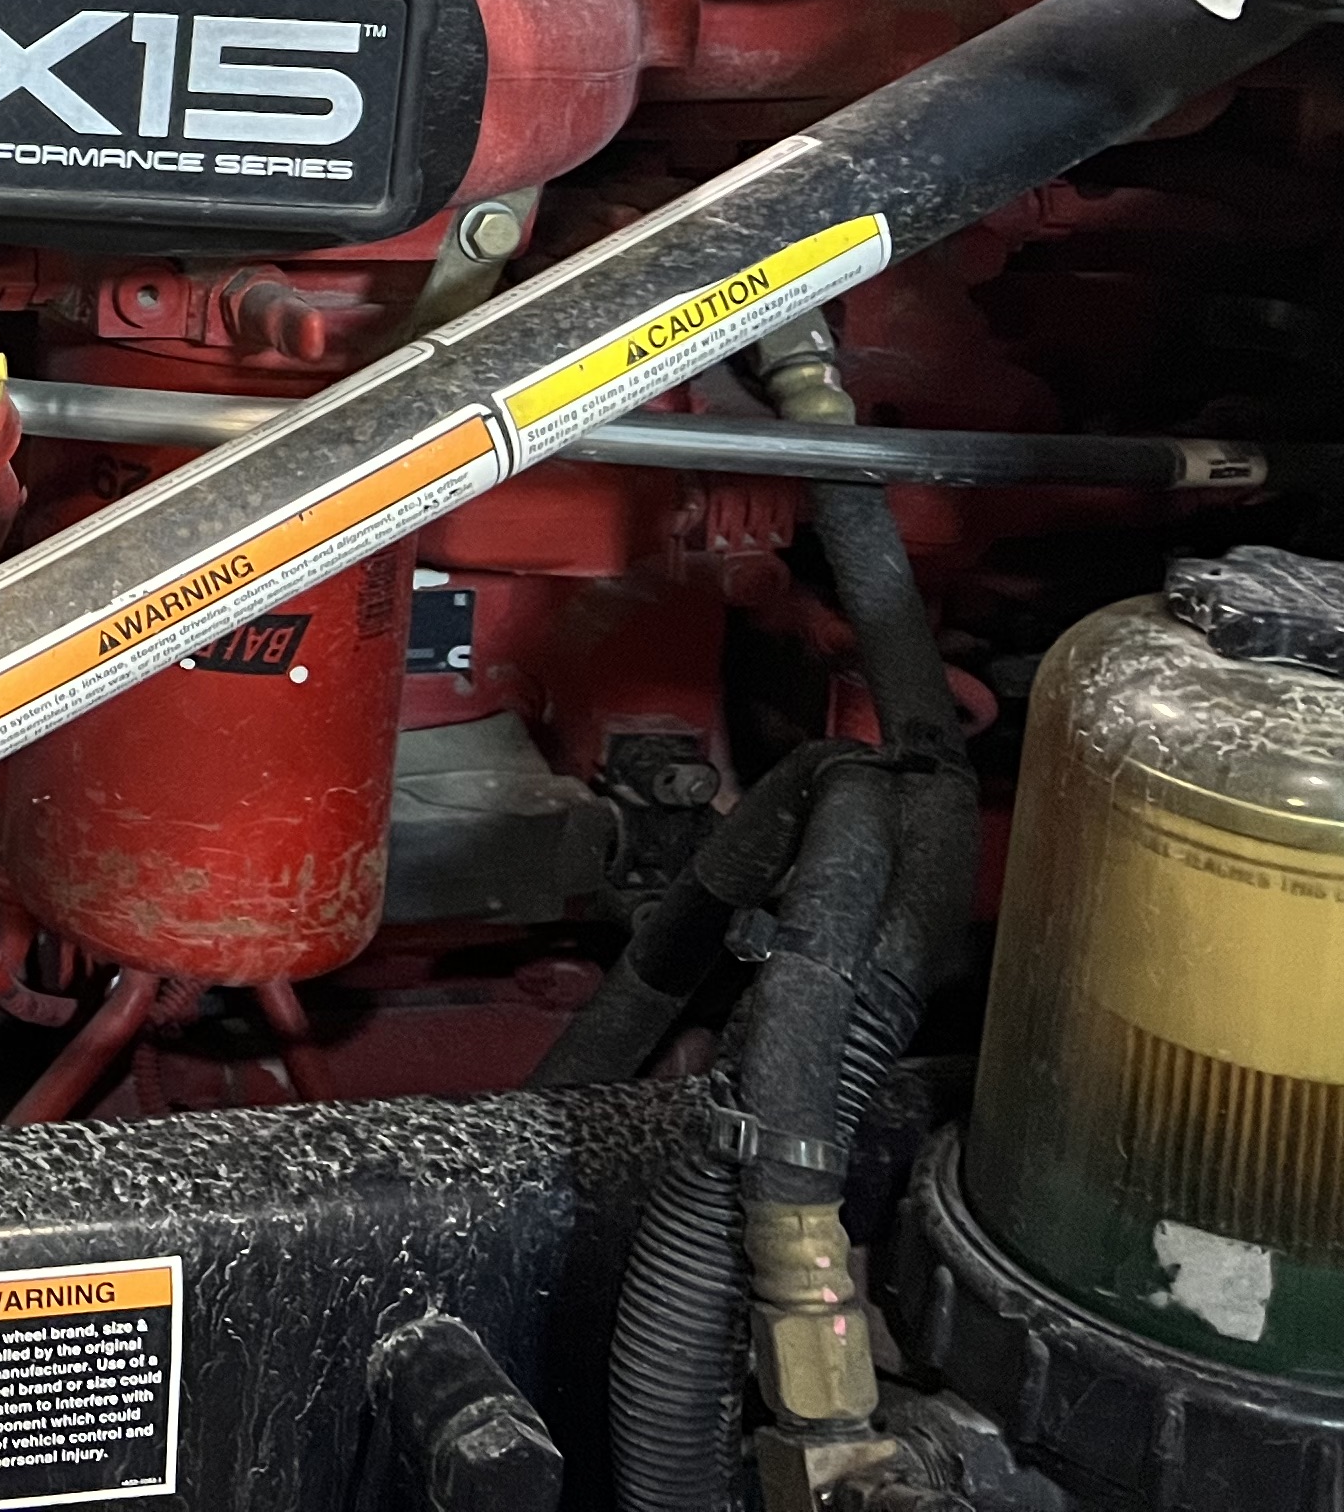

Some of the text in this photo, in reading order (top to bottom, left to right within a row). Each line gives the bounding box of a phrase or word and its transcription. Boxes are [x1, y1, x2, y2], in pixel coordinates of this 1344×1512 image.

[215, 151, 355, 182] SERIES
[648, 268, 771, 349] CAUTION
[525, 407, 580, 443] Steering
[579, 382, 626, 413] column
[640, 342, 700, 380] equipped
[698, 325, 727, 347] with
[8, 699, 53, 730] system
[127, 630, 179, 665] steering
[333, 510, 396, 551] alignment,
[434, 469, 471, 495] either
[111, 551, 256, 643] WARNING
[2, 1329, 46, 1344] wheel
[51, 1325, 98, 1340] brand,
[103, 1321, 132, 1336] size
[137, 1319, 148, 1333] &
[34, 1346, 53, 1361] by
[57, 1344, 81, 1357] the
[85, 1338, 142, 1354] original
[97, 1358, 125, 1372] Use
[129, 1356, 144, 1368] of
[148, 1355, 158, 1367] a
[18, 1382, 62, 1397] brand
[67, 1380, 82, 1392] or
[86, 1376, 116, 1389] size
[120, 1371, 162, 1386] could
[36, 1400, 51, 1412] to
[55, 1395, 118, 1411] interfere
[122, 1390, 153, 1404] with
[51, 1413, 95, 1428] which
[99, 1408, 141, 1423] could
[12, 1433, 65, 1449] vehicle
[69, 1428, 122, 1444] control
[125, 1424, 153, 1438] and
[61, 1447, 108, 1463] injury.
